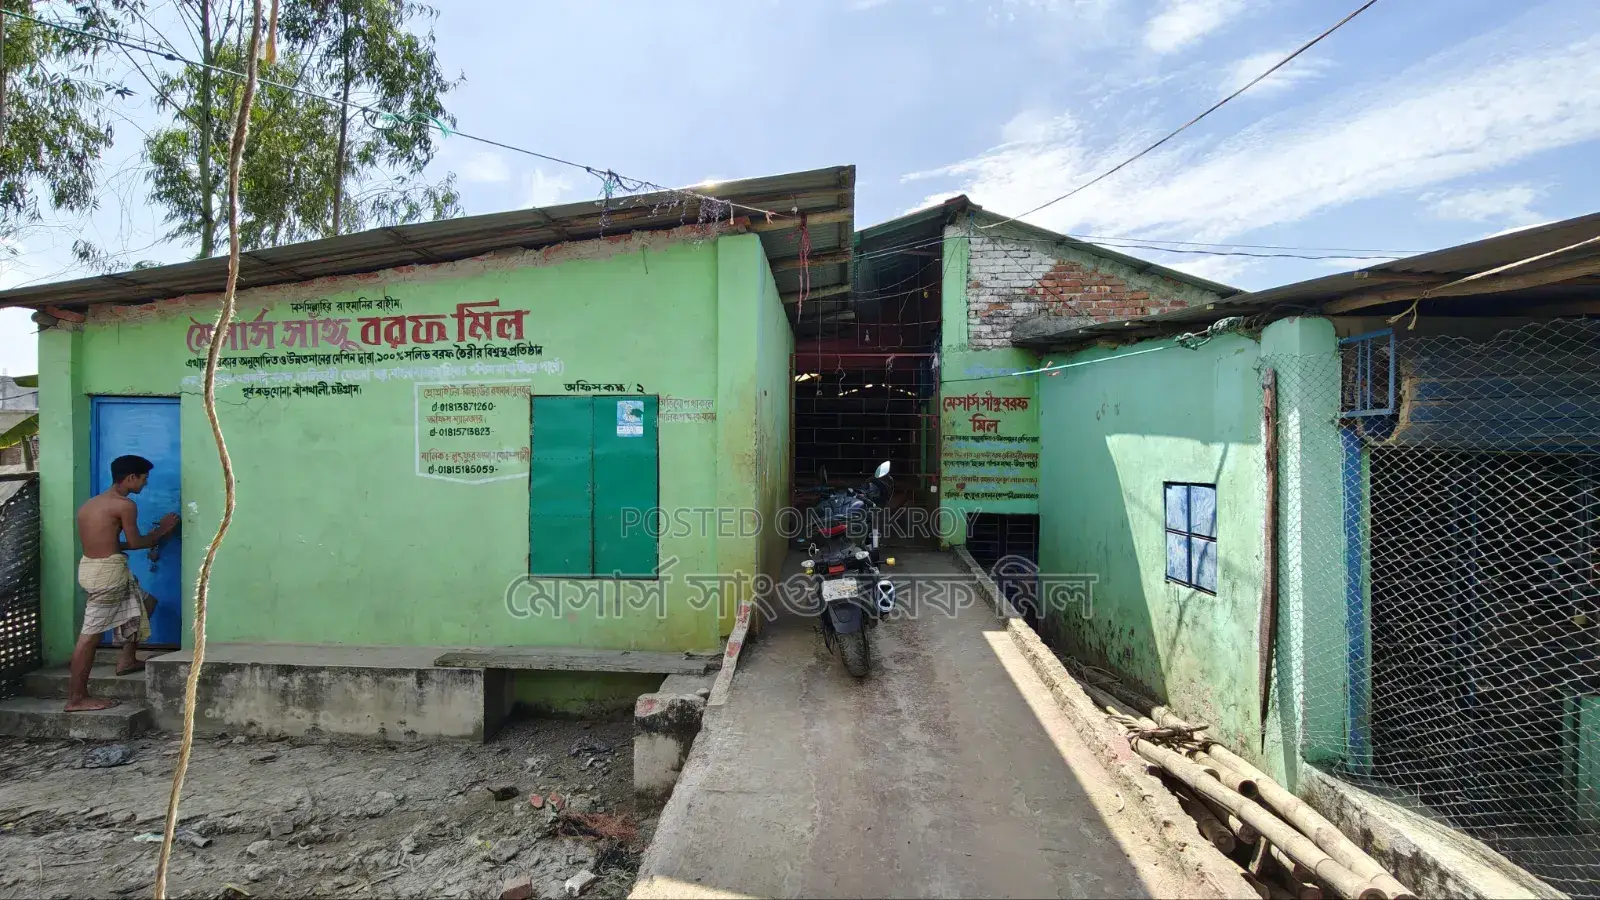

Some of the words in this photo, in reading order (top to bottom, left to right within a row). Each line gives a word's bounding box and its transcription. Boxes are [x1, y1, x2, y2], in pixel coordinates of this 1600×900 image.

[336, 297, 372, 313] রাহমানির
[357, 314, 449, 349] বরফ
[450, 298, 531, 342] মিল
[404, 347, 431, 361] সলিড
[432, 349, 454, 360] বরফ
[1002, 396, 1031, 411] বরফ
[968, 413, 1001, 433] মিল
